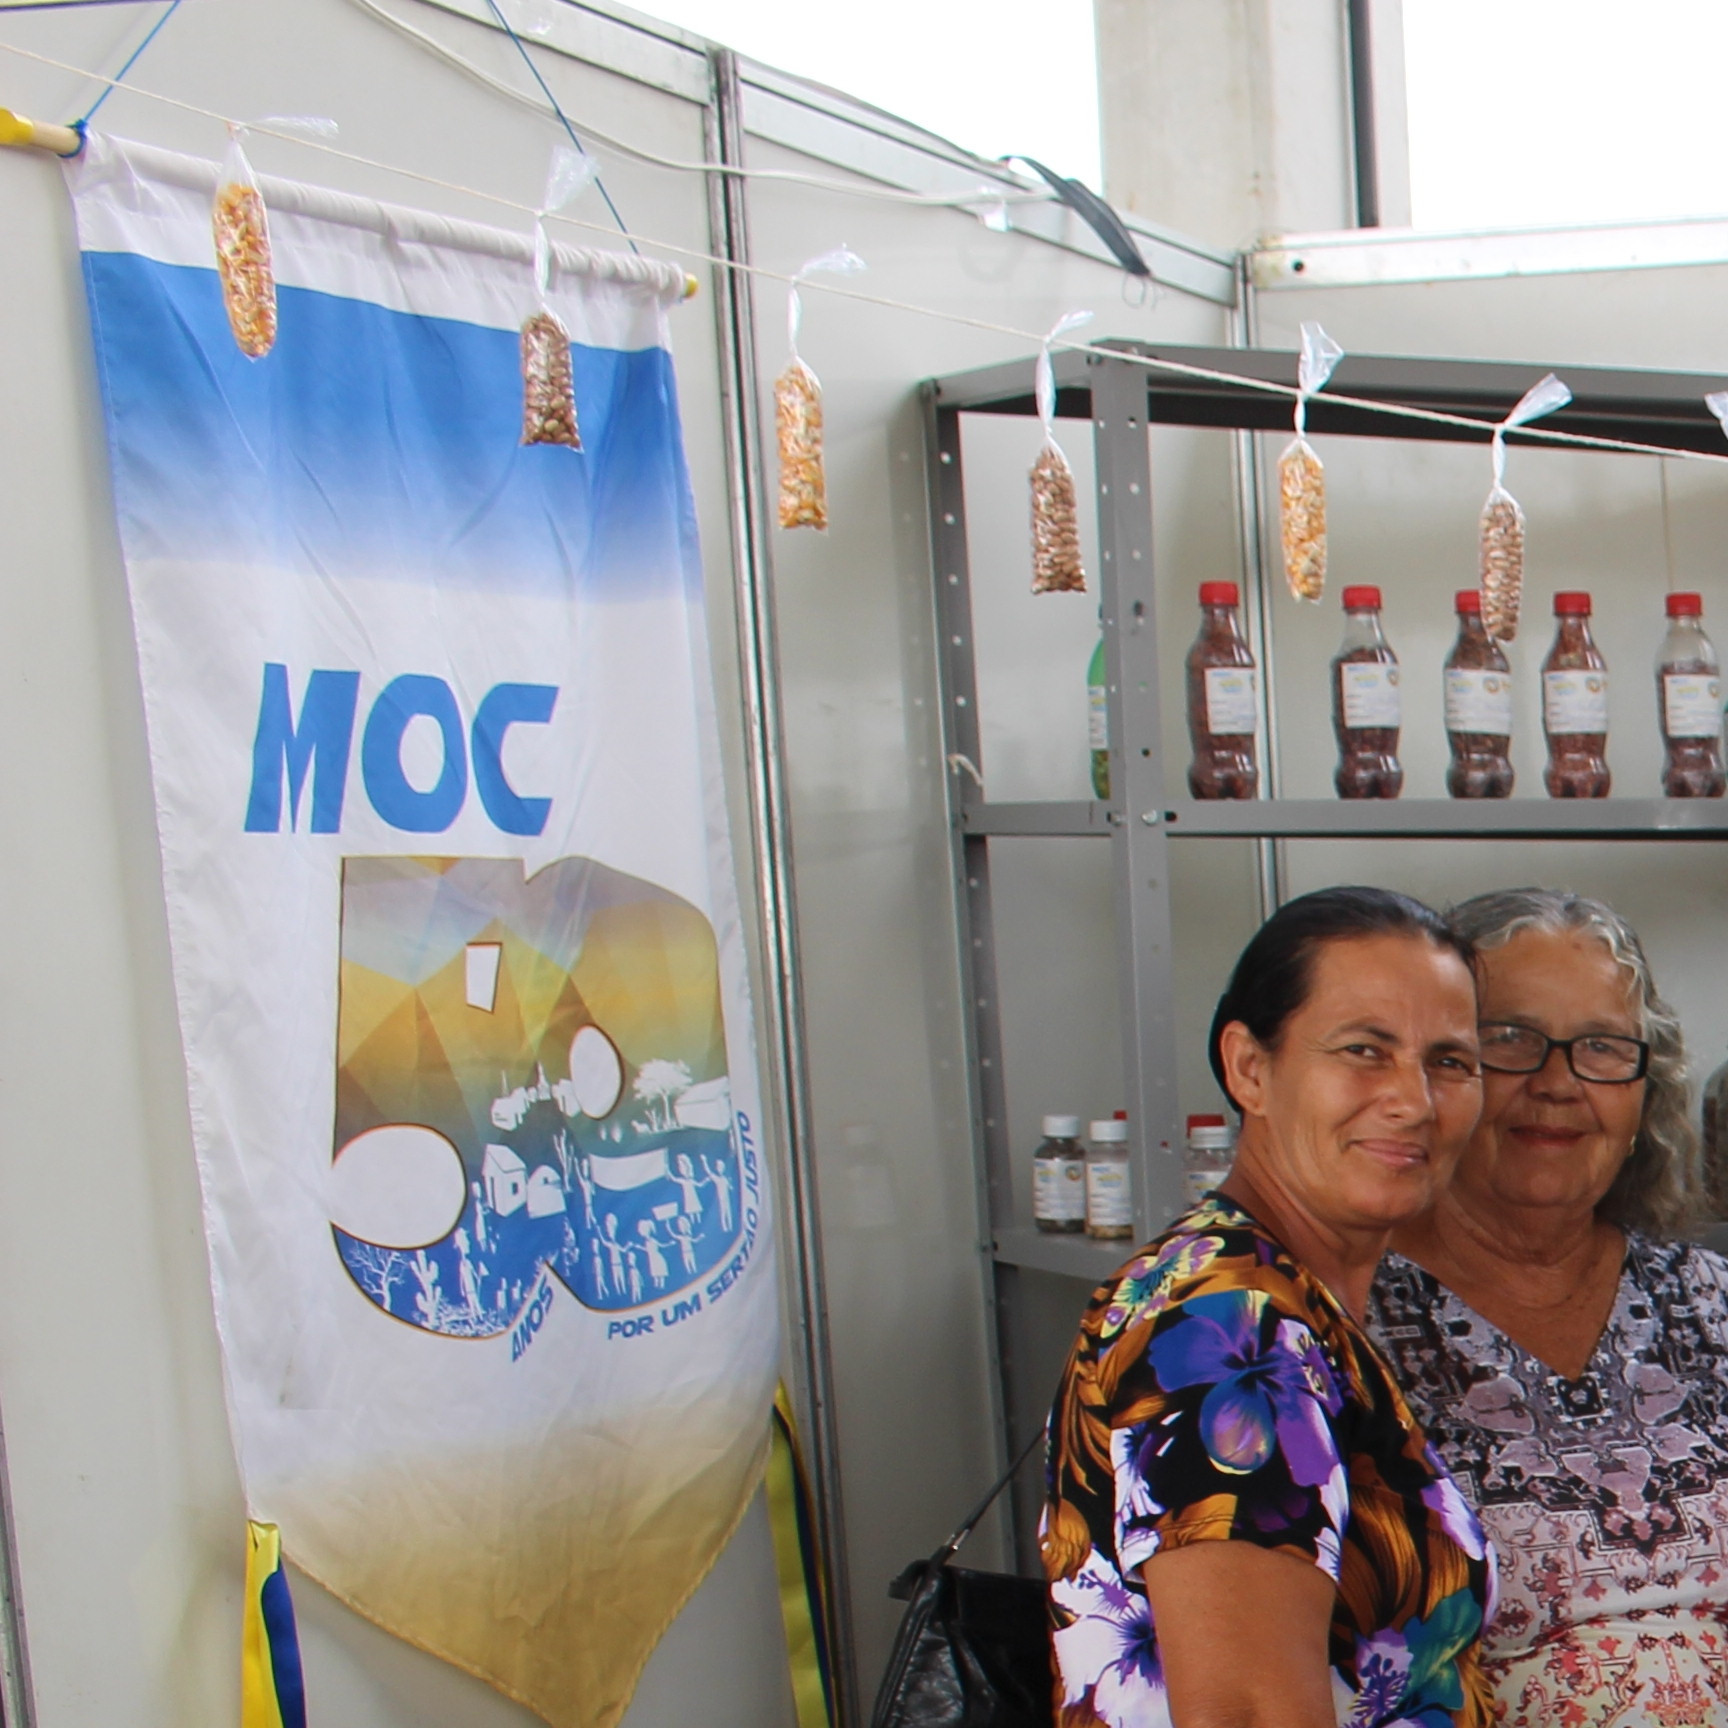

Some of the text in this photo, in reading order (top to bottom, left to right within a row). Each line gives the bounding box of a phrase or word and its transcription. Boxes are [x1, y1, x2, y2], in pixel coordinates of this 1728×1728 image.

[244, 663, 559, 836] MOC
[737, 1110, 759, 1204] JUSTO
[512, 1276, 553, 1362] ANOS
[607, 1315, 654, 1339] POR
[661, 1294, 703, 1327] UM
